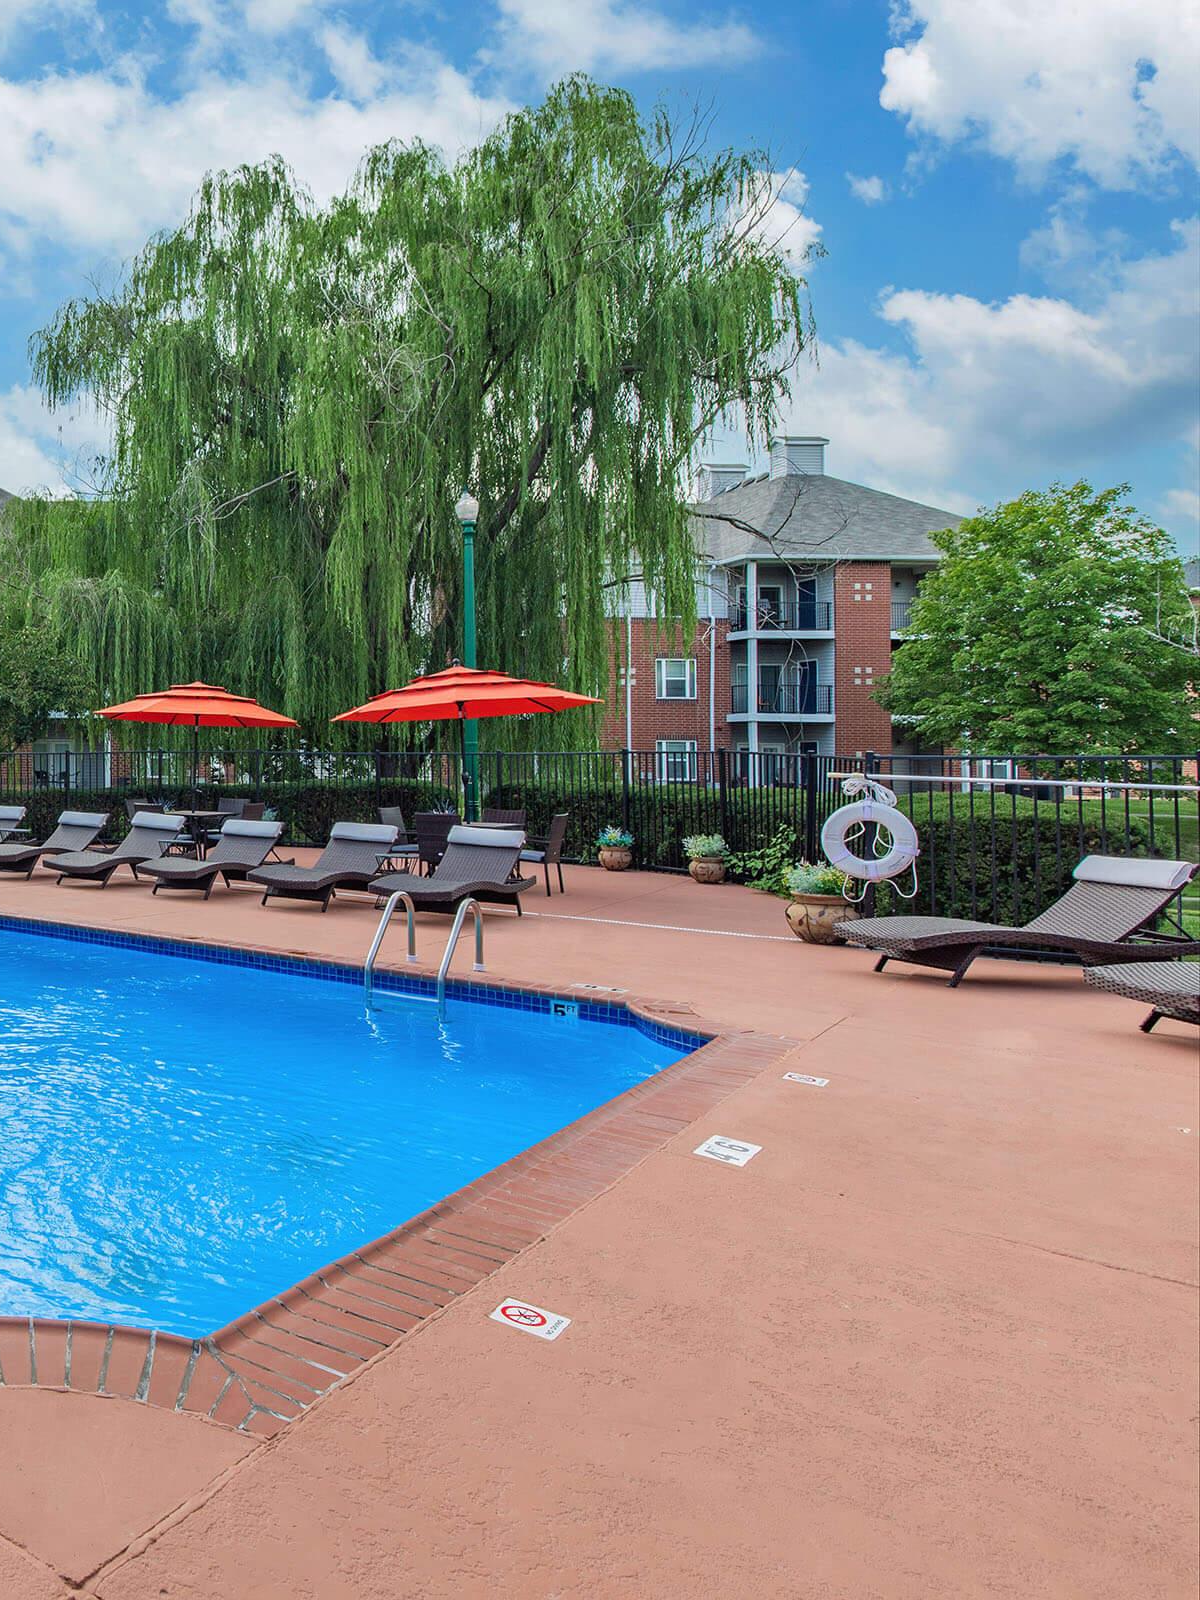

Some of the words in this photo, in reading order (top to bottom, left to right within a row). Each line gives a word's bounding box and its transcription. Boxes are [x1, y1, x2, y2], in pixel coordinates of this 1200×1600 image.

[554, 1003, 567, 1016] 5
[567, 1005, 576, 1013] FT
[704, 1149, 740, 1161] 4
